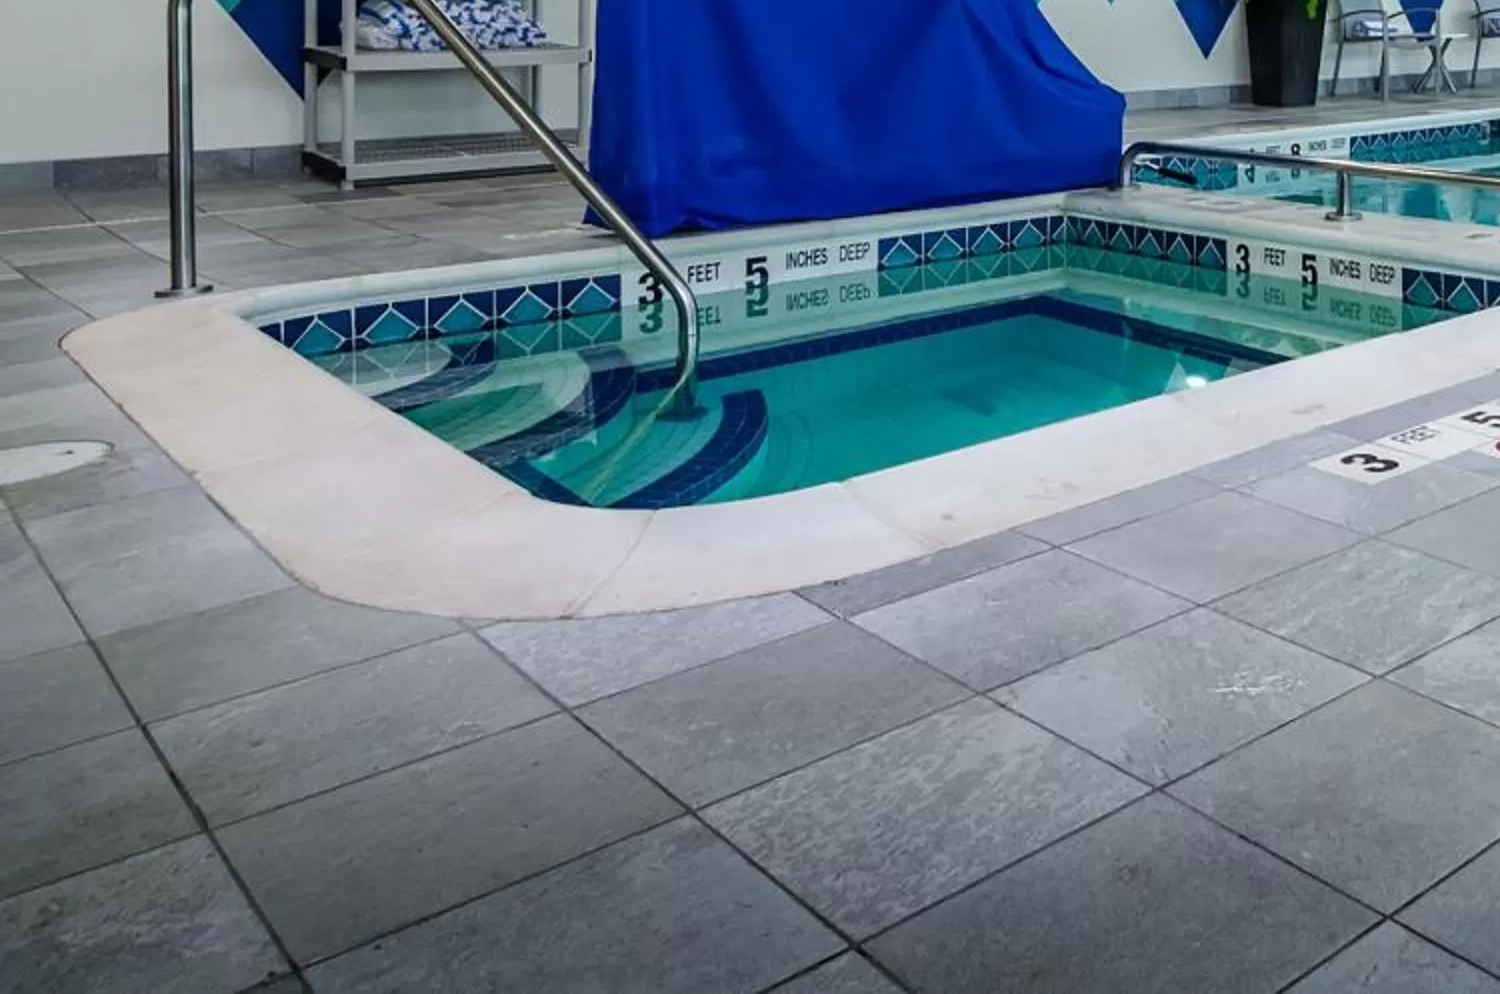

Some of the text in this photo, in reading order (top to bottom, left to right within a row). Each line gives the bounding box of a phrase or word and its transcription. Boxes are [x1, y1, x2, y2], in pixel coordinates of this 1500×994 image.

[638, 241, 871, 305] 3 FEET 5 INCHES DEEP
[1235, 243, 1396, 285] 3 FEET 5 INCHES DEEP
[1340, 453, 1400, 473] 3
